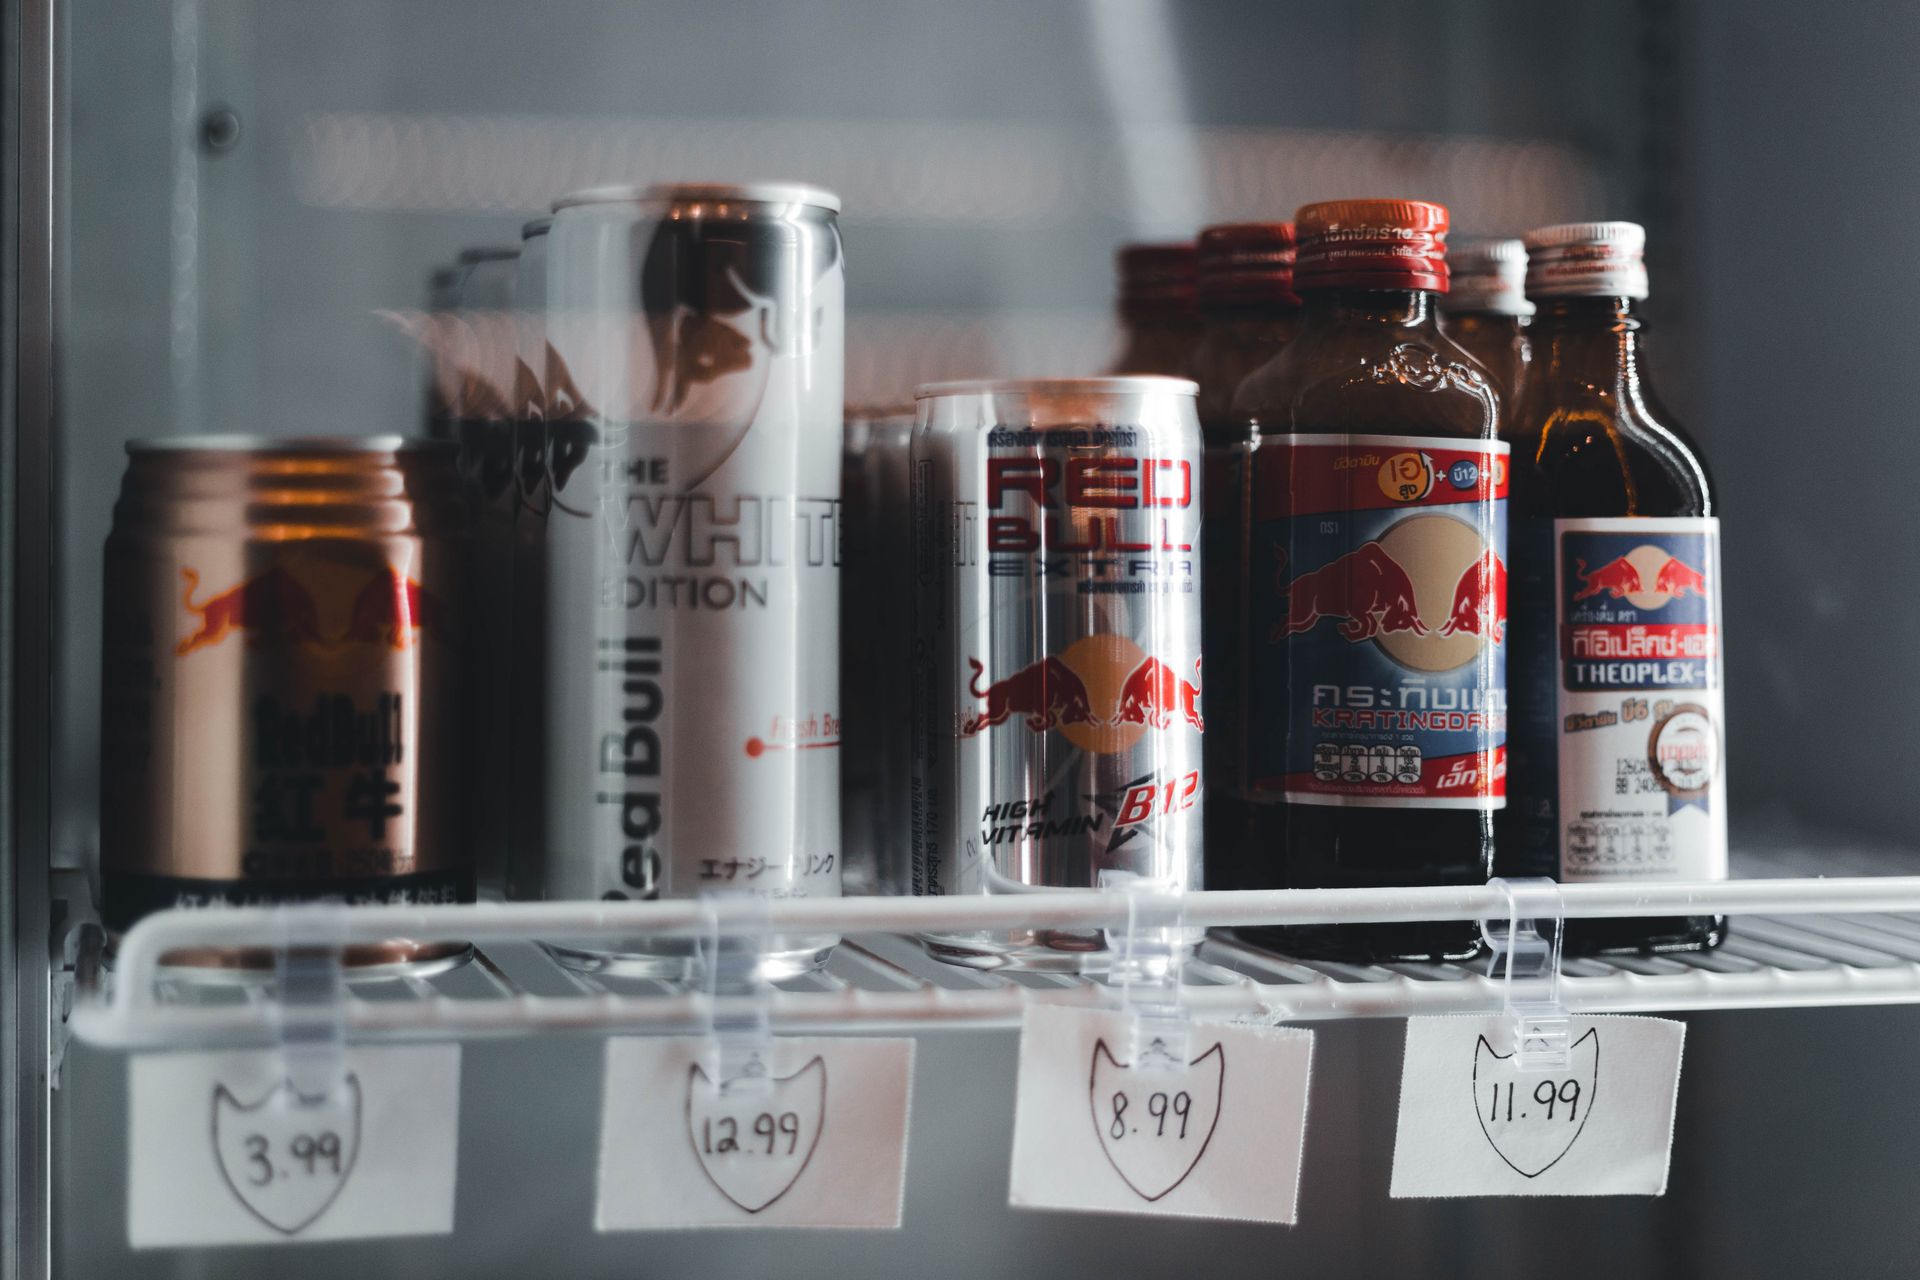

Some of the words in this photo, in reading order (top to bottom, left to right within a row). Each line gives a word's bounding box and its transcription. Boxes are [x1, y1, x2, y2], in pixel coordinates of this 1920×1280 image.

[987, 457, 1192, 509] RED
[600, 494, 841, 568] WHIT
[987, 515, 1192, 552] BULL
[988, 558, 1192, 578] EXTRA
[1575, 661, 1714, 684] THEOPLEX-
[982, 789, 1055, 822] HIGH
[1113, 768, 1200, 828] B12
[598, 792, 662, 900] ed
[982, 813, 1104, 846] VITAMIN
[699, 853, 835, 882] エナジーリンク
[1109, 1090, 1193, 1141] 8.99
[1490, 1079, 1581, 1122] 11.99
[703, 1111, 800, 1156] 12.99
[245, 1131, 342, 1187] 3.99
